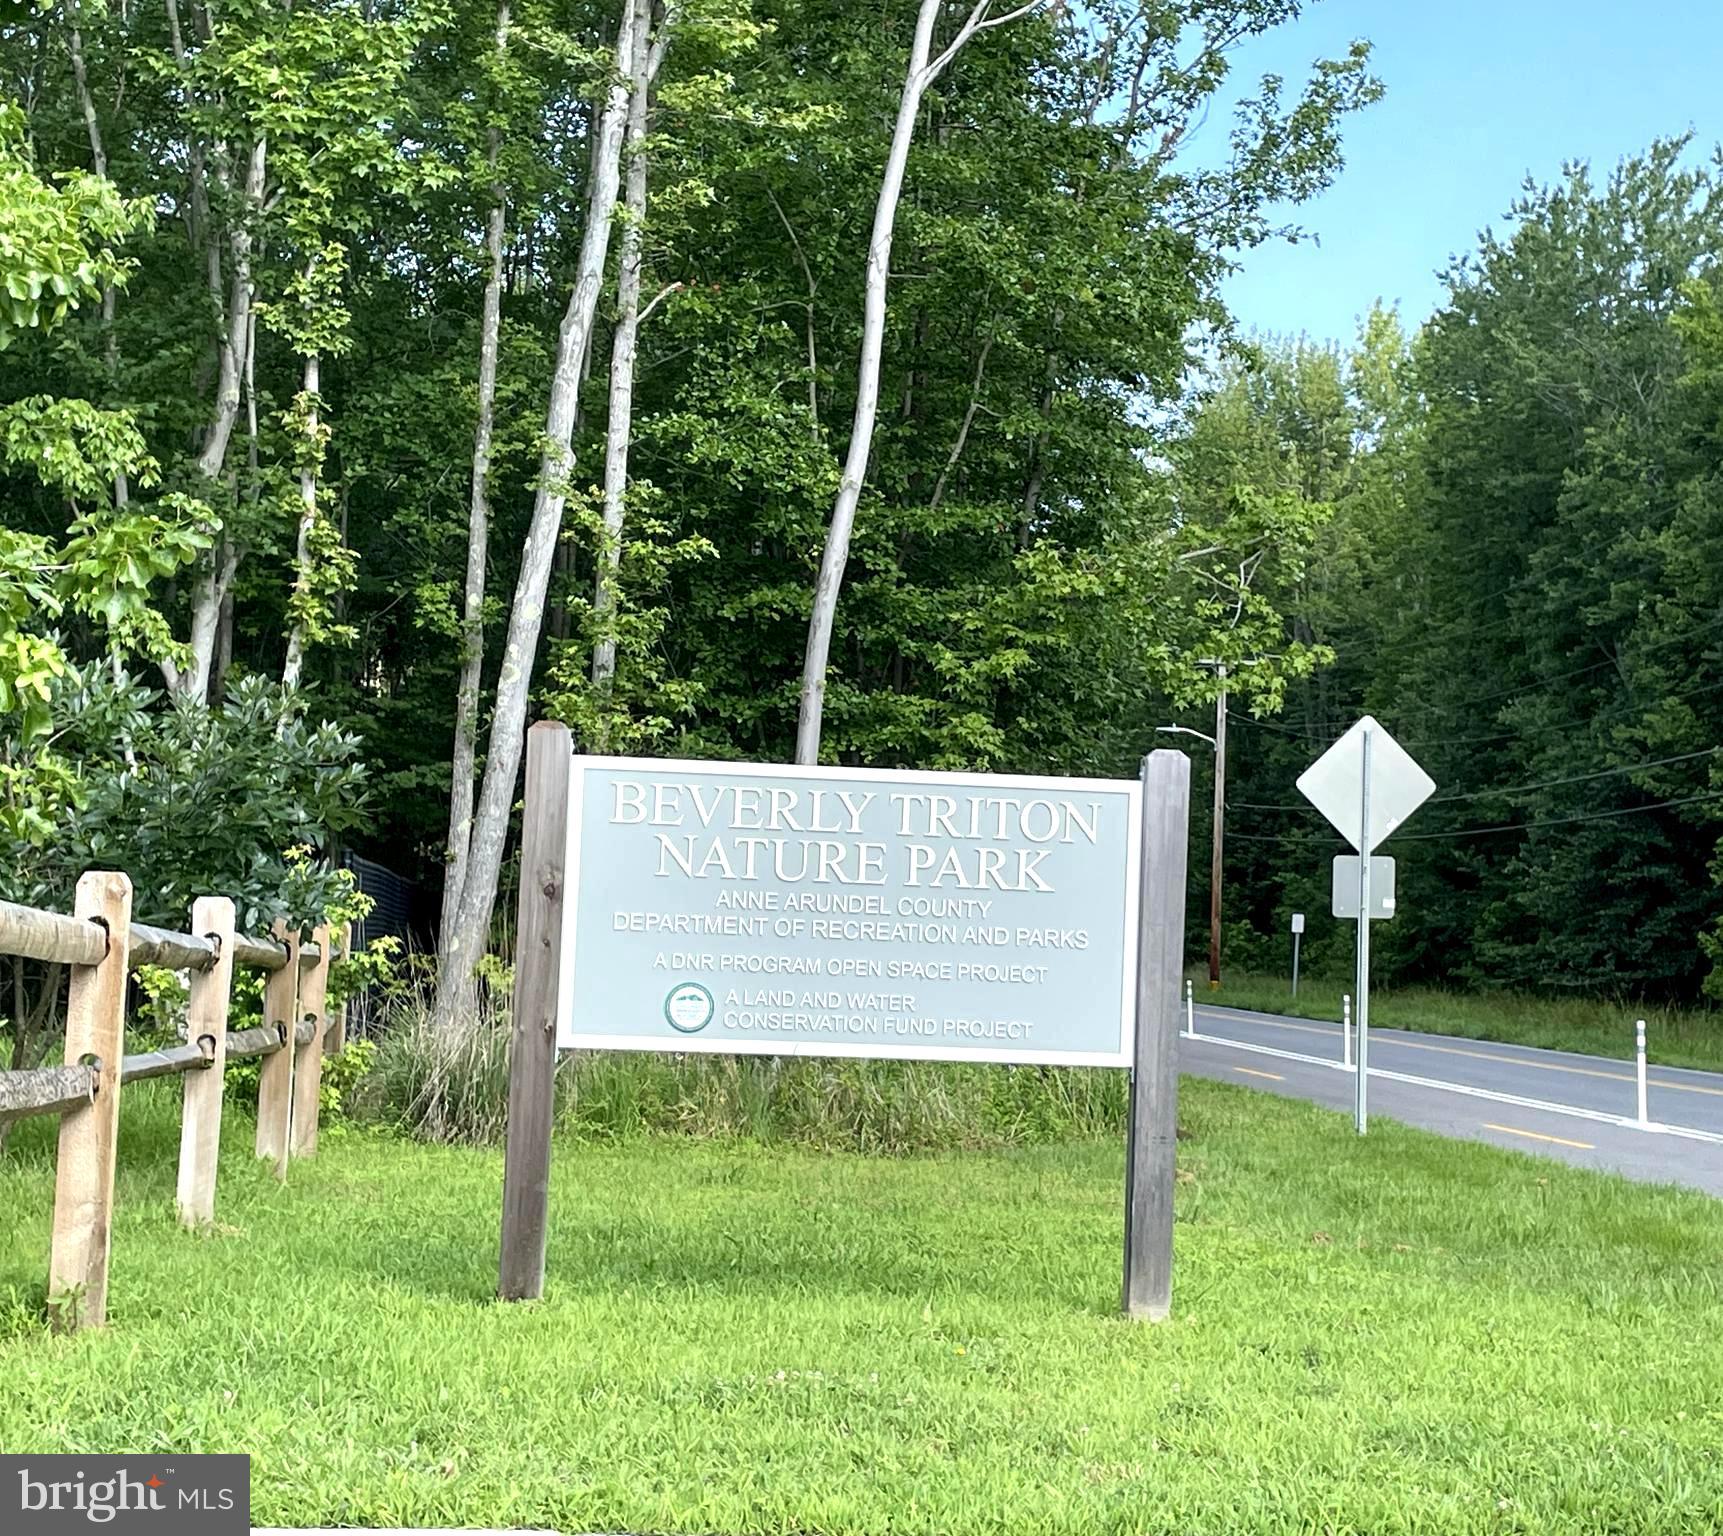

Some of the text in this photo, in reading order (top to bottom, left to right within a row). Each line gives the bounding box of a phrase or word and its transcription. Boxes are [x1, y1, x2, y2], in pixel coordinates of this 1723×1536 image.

[609, 780, 1102, 844] BEVERLY TRITON
[653, 833, 1055, 892] NATURE PARK
[715, 890, 992, 919] ANNE ARUNDEL COUNTY
[613, 912, 1089, 949] DEPARTMENT OF RECREATION AND PARKS
[652, 952, 1048, 984] A DNR PROGRAM OPEN SPACE PROJECT
[725, 989, 916, 1012] A LAND AND WATER
[723, 1011, 880, 1034] CONSERVATION
[883, 1017, 937, 1035] FUND
[942, 1019, 1033, 1039] PROJECT
